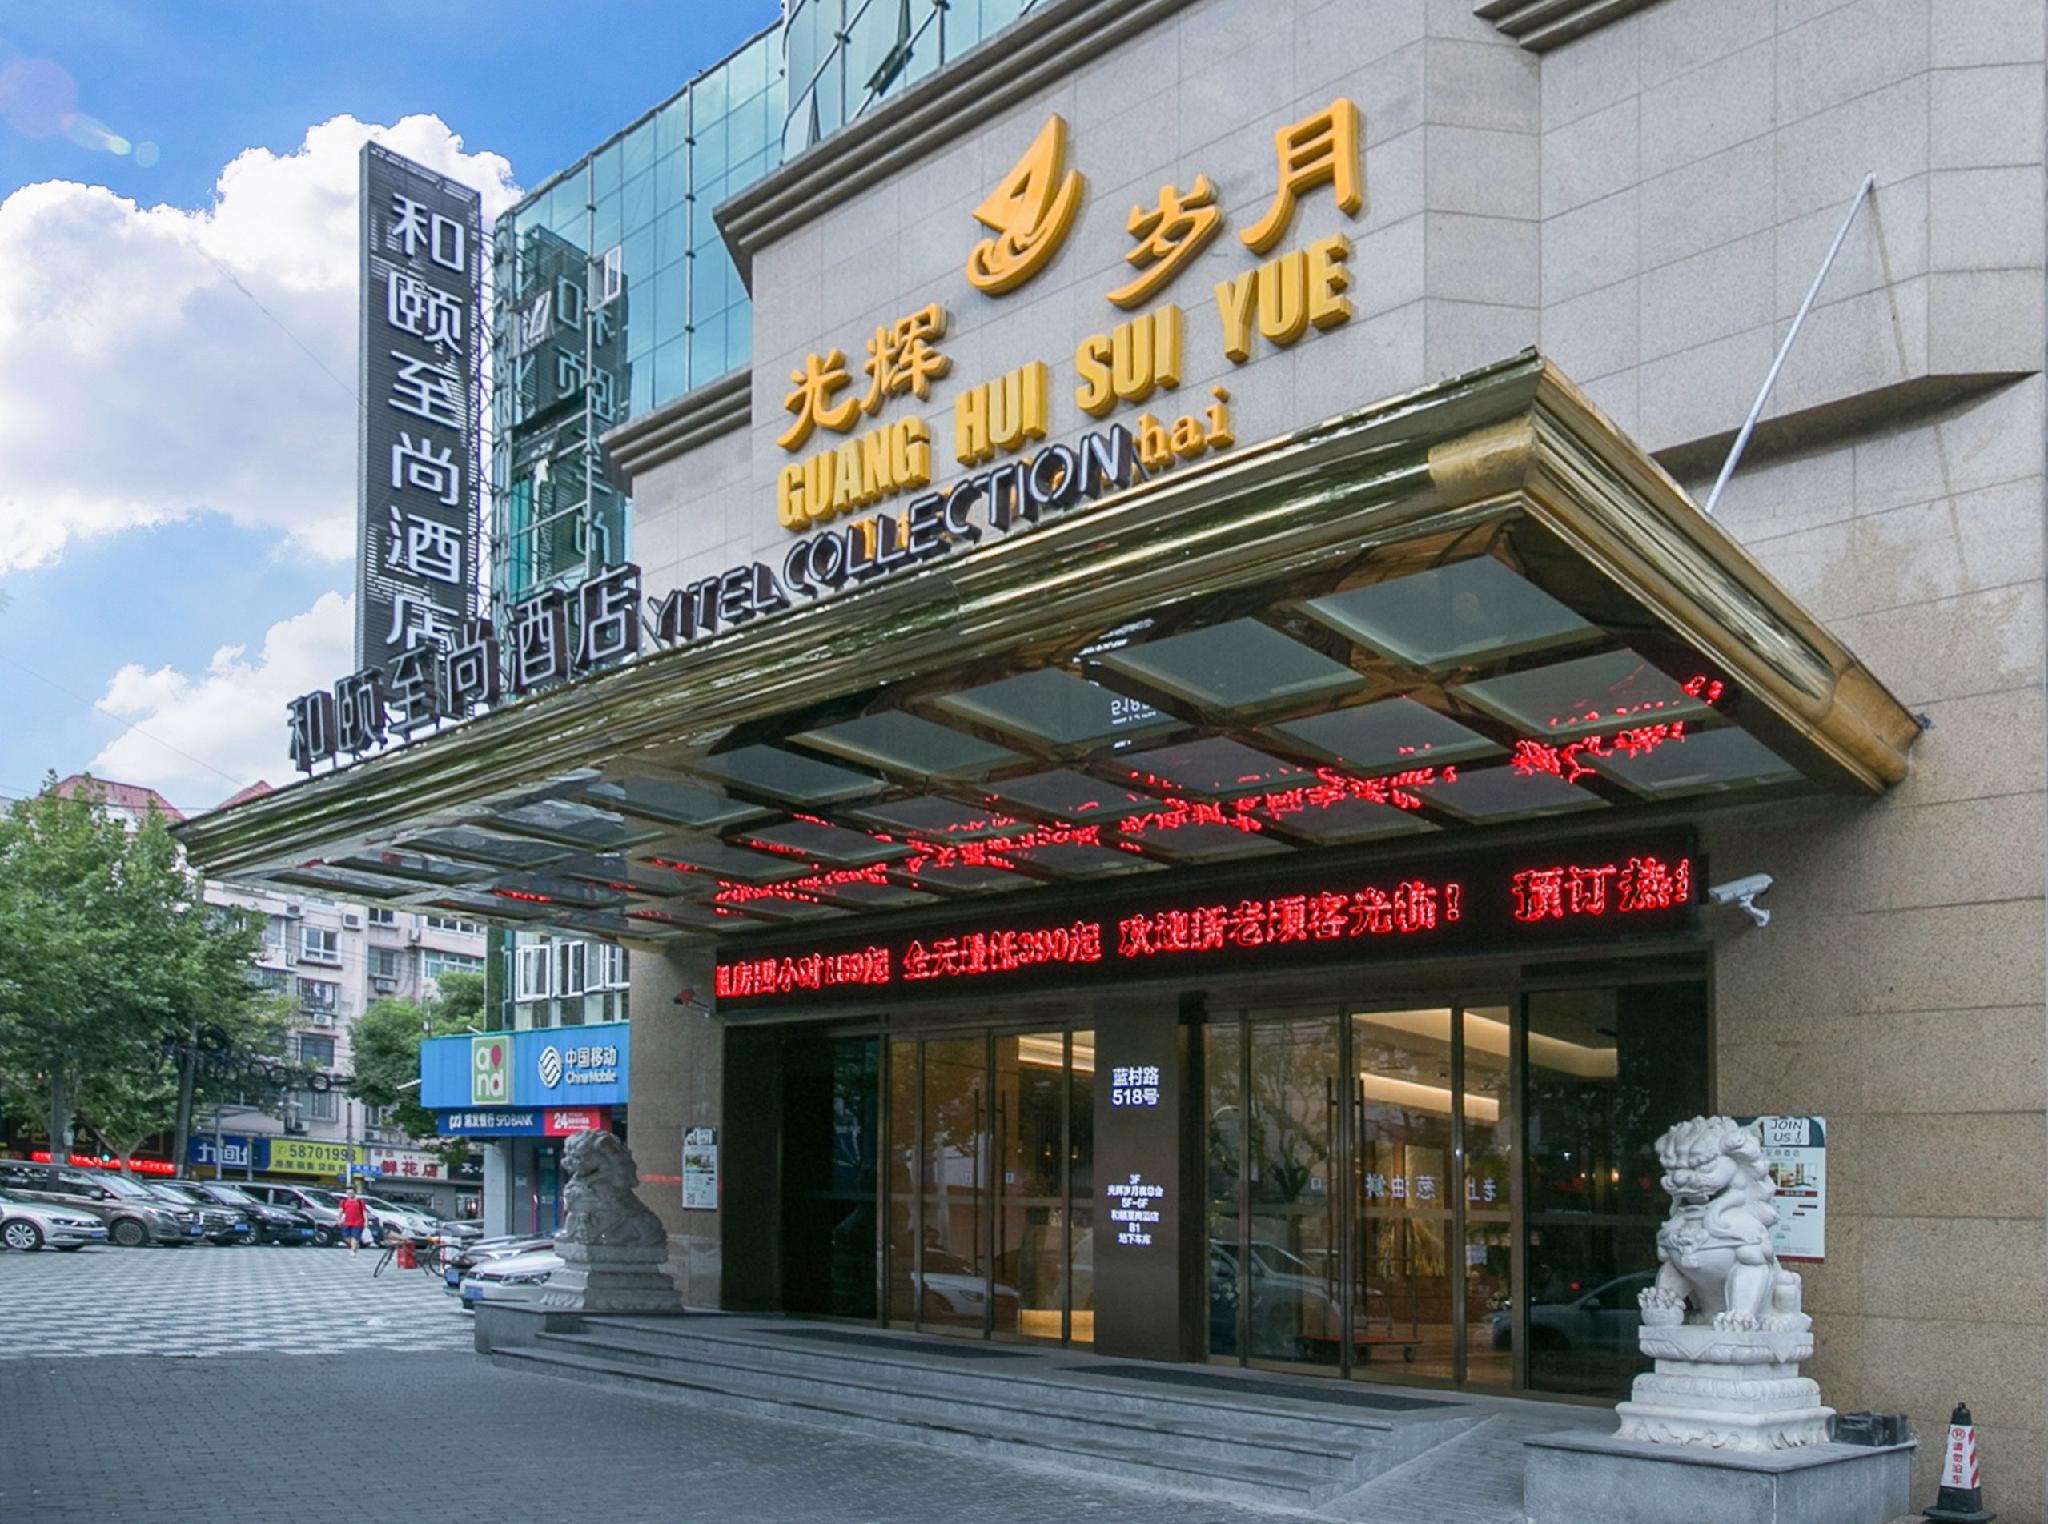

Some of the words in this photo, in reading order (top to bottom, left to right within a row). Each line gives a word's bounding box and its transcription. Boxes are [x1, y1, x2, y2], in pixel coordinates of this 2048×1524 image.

[778, 302, 952, 451] 光辉
[1106, 96, 1366, 309] 岁月
[777, 413, 932, 531] GUANG
[954, 360, 1049, 467] HUI
[1074, 303, 1184, 417] SUI
[1214, 233, 1353, 363] YUE
[384, 191, 466, 652] 和颐至尚酒店
[287, 562, 641, 771] 和颐至尚酒店
[648, 561, 782, 646] YITEL
[783, 422, 1136, 600] COLLECTION
[566, 1046, 617, 1068] 中国移动
[1112, 1066, 1160, 1087] 蓝村路
[1112, 1088, 1160, 1106] 518号
[553, 1113, 568, 1130] 24
[1770, 1119, 1803, 1131] JOIN
[380, 1159, 439, 1178] 鲜花店
